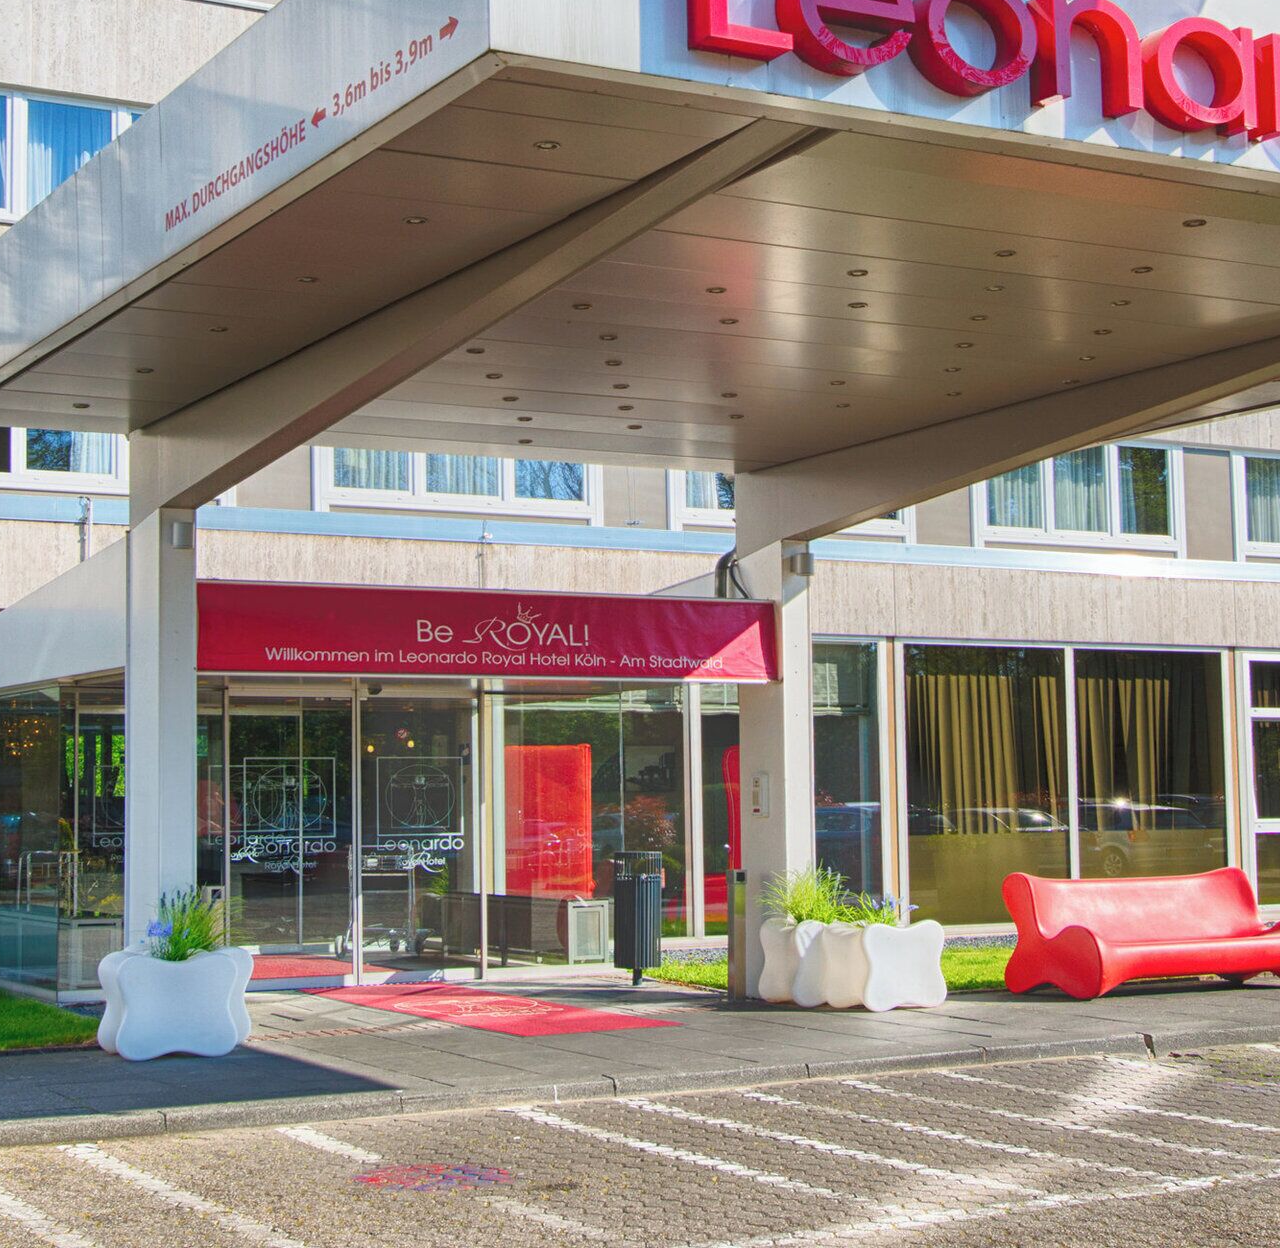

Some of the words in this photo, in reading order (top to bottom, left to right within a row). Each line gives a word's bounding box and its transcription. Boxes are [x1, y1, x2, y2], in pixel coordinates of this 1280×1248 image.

[165, 199, 191, 232] MAX.
[193, 117, 307, 214] DURCHGANGSHÖHE
[332, 79, 367, 116] 3,6m
[370, 61, 392, 92] bis
[395, 33, 433, 77] 3,9m
[416, 619, 454, 644] Be
[462, 616, 590, 651] ROYAL!
[265, 646, 370, 663] Willkommen
[374, 648, 394, 663] im
[398, 649, 477, 664] Leonardo
[481, 651, 526, 667] Royal
[530, 652, 570, 666] Hotel
[574, 652, 606, 668] Köln
[619, 654, 646, 668] Am
[649, 655, 724, 670] Stadtwald
[376, 835, 465, 851] Leonardo
